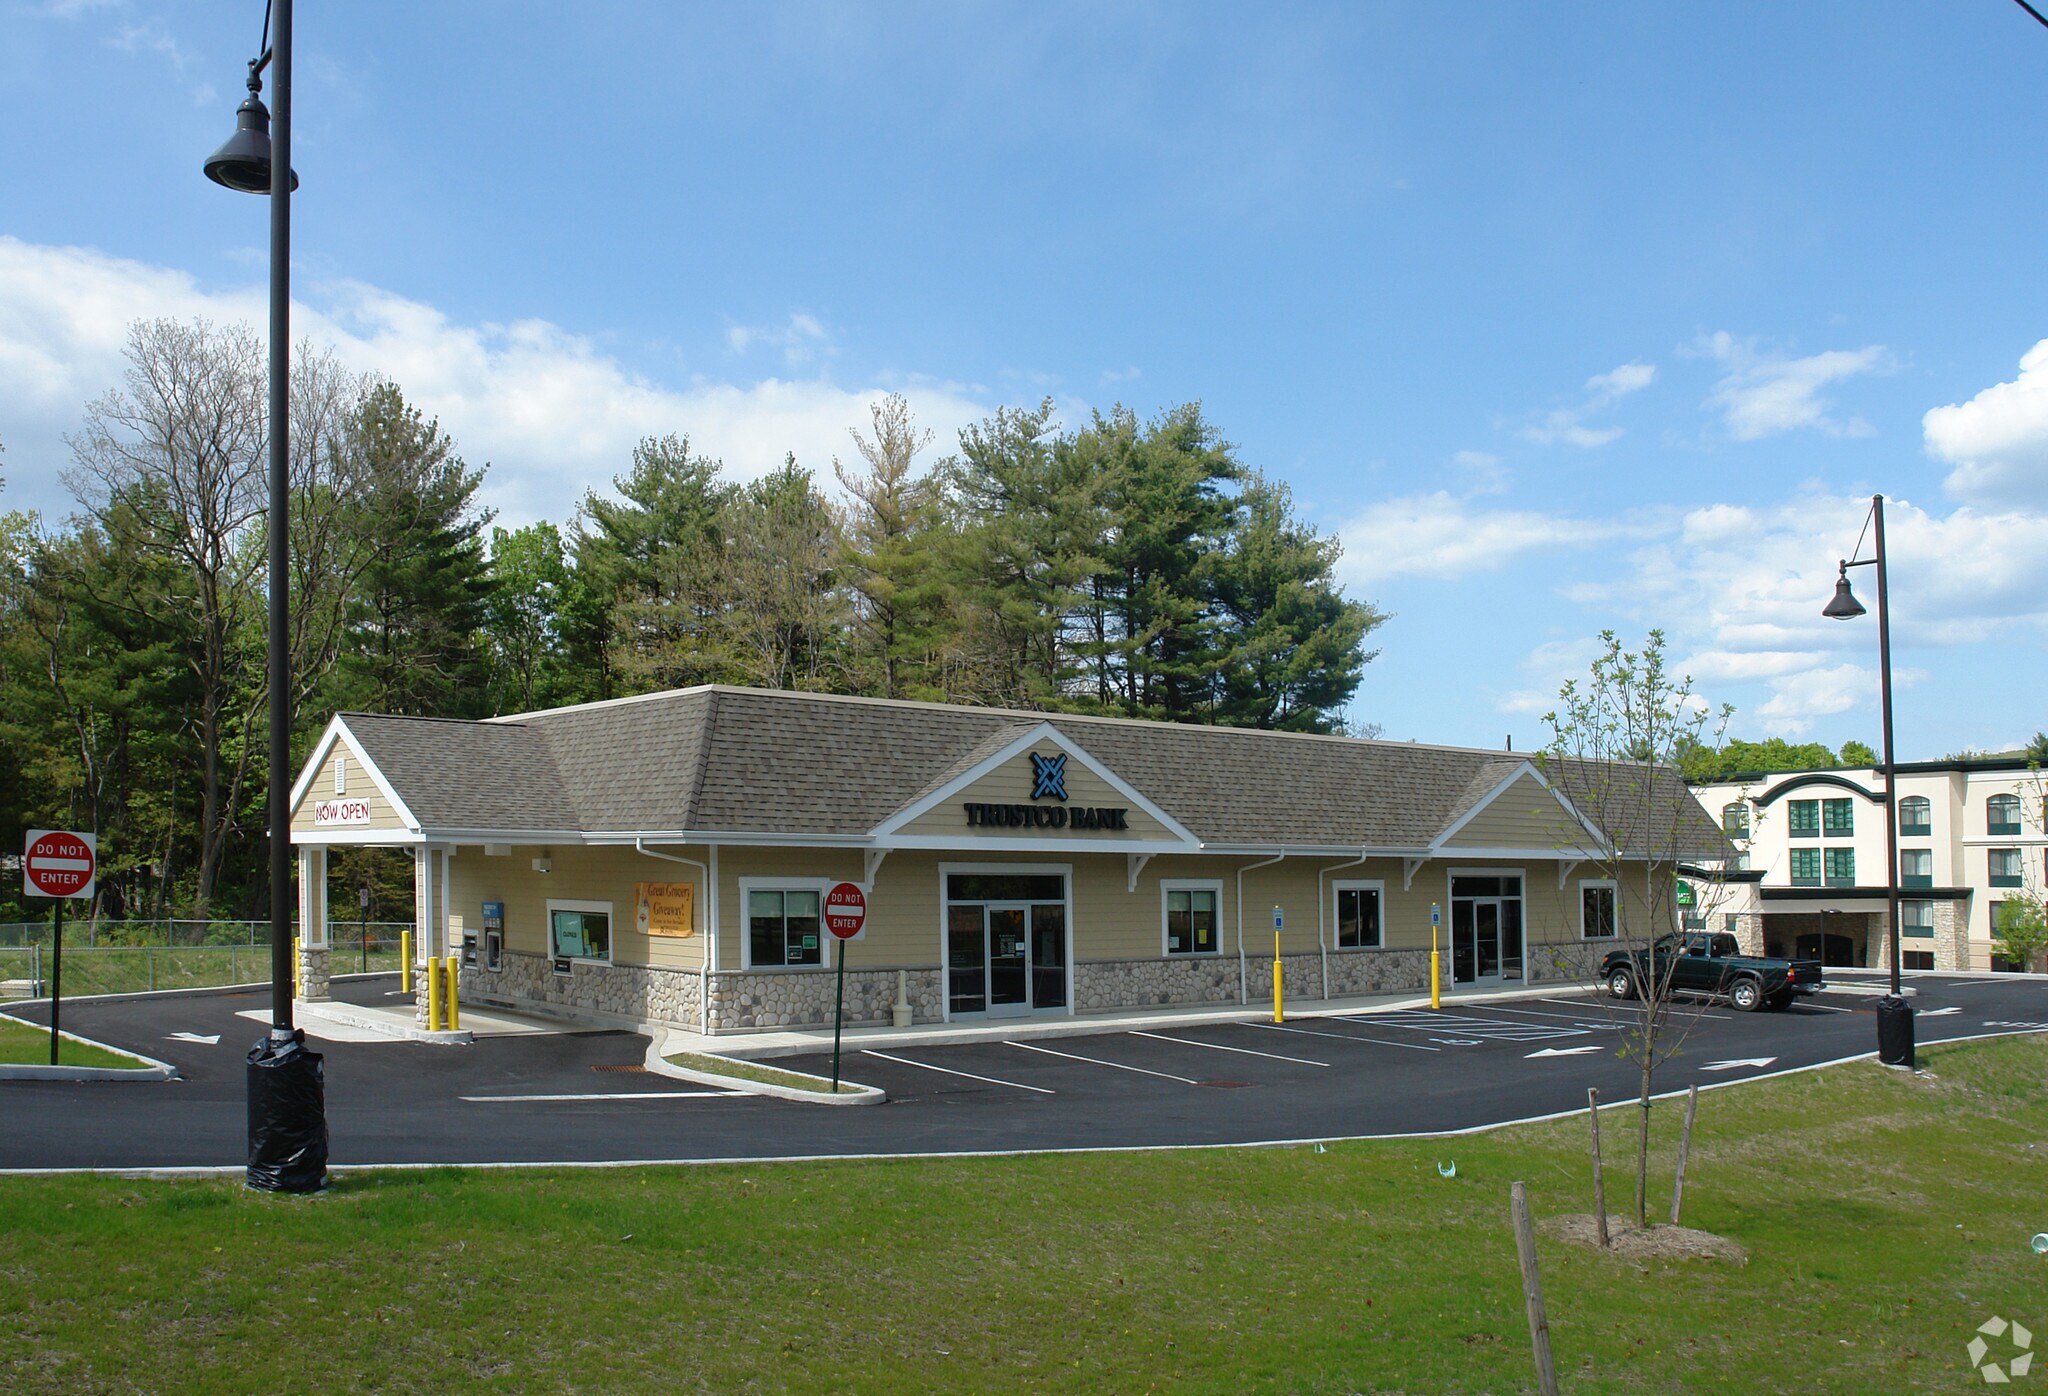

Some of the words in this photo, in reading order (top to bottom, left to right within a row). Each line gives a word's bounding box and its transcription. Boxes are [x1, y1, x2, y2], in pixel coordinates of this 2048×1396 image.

[316, 804, 338, 820] NOW
[341, 802, 369, 819] OPEN
[963, 802, 1068, 828] TRUSTCO
[1069, 806, 1129, 830] BANK
[37, 844, 54, 855] DO
[60, 845, 84, 856] NOT
[41, 872, 79, 884] ENTER
[665, 884, 690, 901] Grocery
[831, 893, 842, 903] DO
[845, 894, 861, 903] NOT
[653, 902, 684, 919] Giveaway!
[833, 918, 857, 928] ENTER
